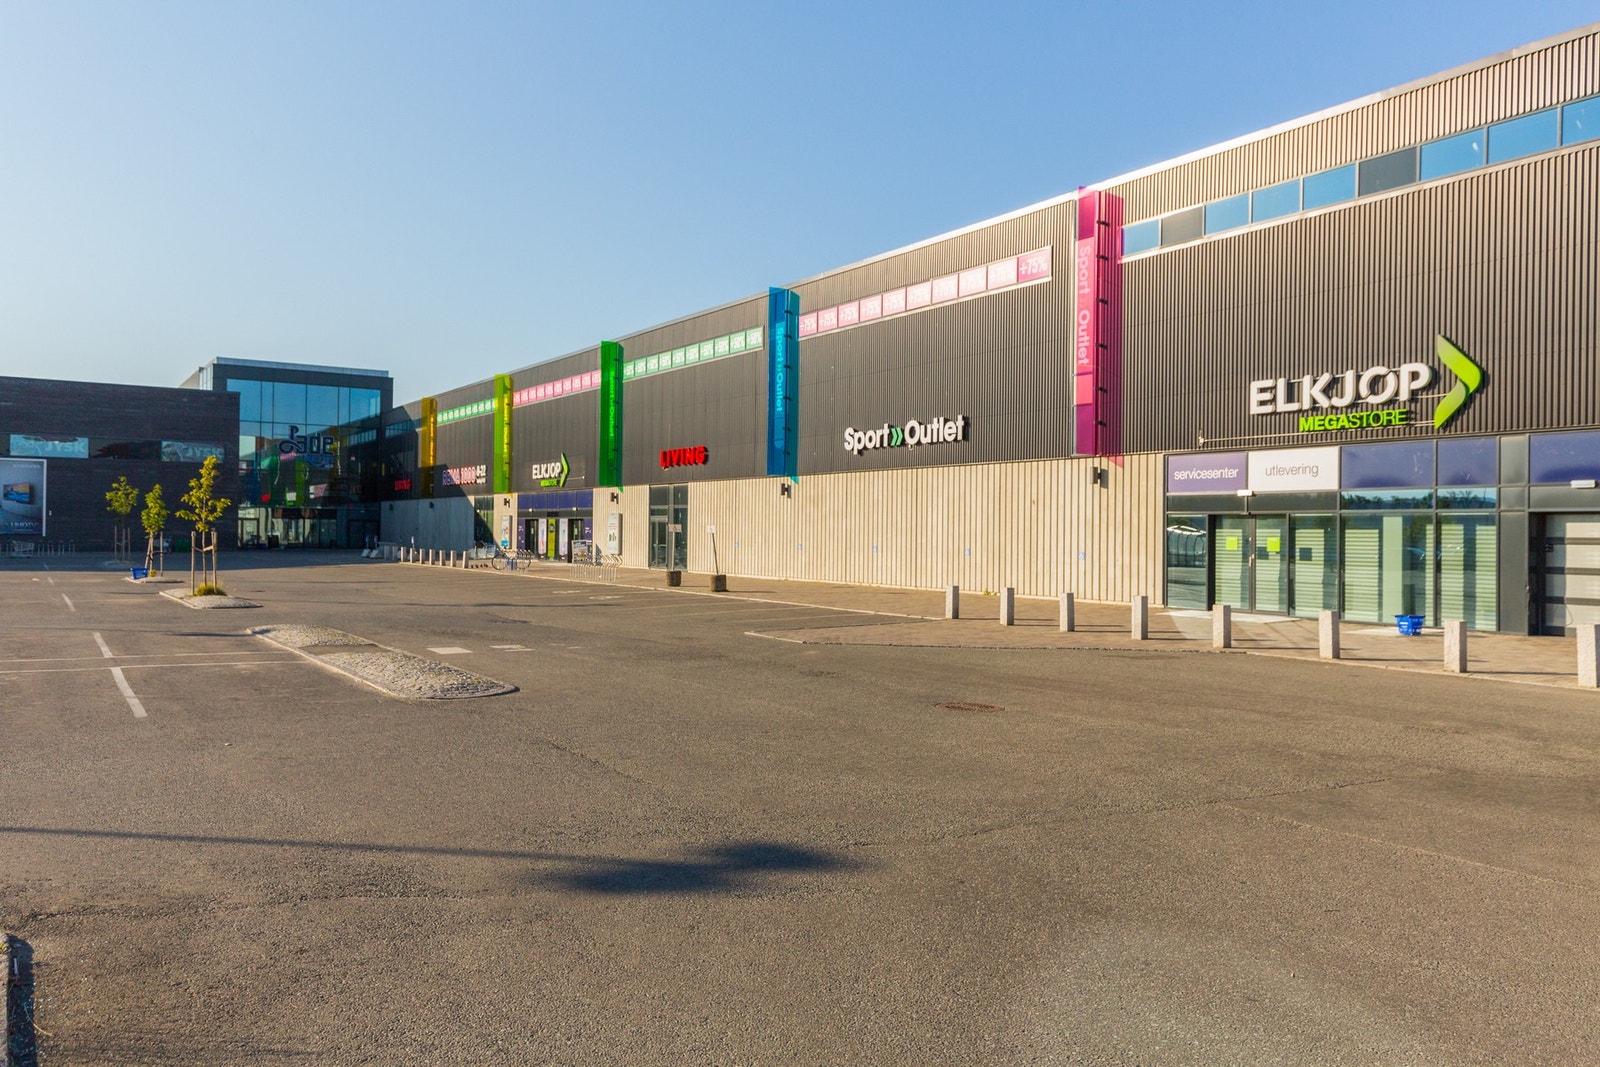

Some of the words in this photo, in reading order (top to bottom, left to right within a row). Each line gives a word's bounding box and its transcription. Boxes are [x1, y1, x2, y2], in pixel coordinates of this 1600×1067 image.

[1020, 255, 1047, 275] ÷75%
[1078, 245, 1090, 295] Sport
[1077, 309, 1090, 365] Outlet
[1299, 408, 1408, 432] MEGASTORE
[844, 423, 890, 454] Sport
[905, 414, 965, 446] Outlet
[659, 445, 708, 468] LIVING
[1174, 466, 1239, 481] servicesenter
[1265, 463, 1319, 478] utlevering
